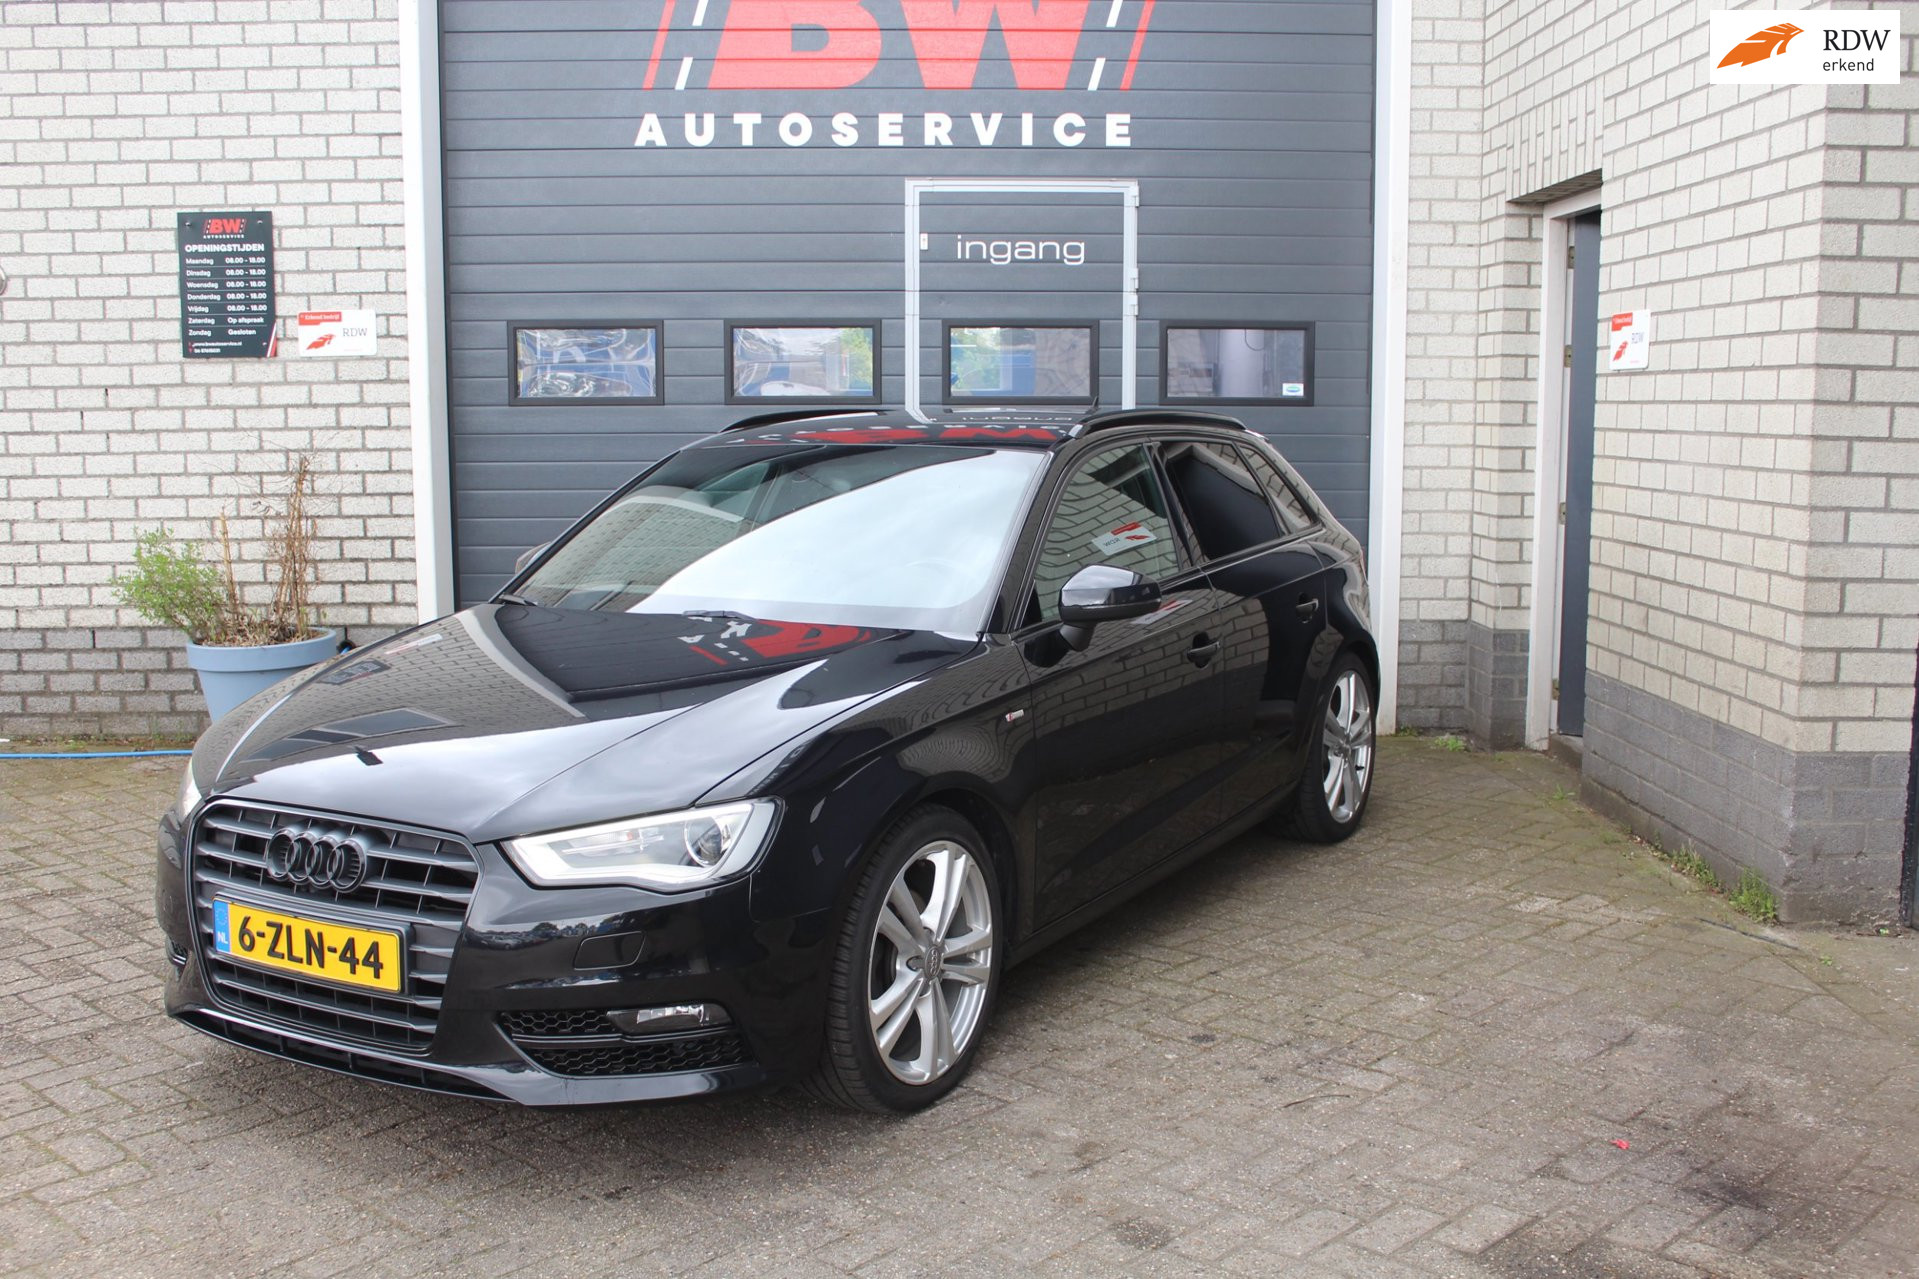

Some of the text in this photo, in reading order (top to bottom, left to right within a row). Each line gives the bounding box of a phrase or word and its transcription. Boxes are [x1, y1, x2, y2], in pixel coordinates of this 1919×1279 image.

[634, 112, 1132, 147] AUTOSERVICE
[209, 218, 241, 234] BW
[185, 243, 265, 253] OPENINGSTIJDEN
[957, 235, 1085, 265] ingang
[186, 269, 211, 277] Dinsdag
[187, 281, 219, 289] Woensdag
[187, 293, 221, 301] Donderdag
[187, 305, 209, 313] Vrijdag
[188, 317, 215, 325] Zaterdag
[238, 316, 264, 324] afspraak
[188, 329, 211, 337] Zondag
[342, 327, 368, 337] RDW
[217, 930, 229, 945] NL
[238, 915, 384, 980] 6-ZLN-44
